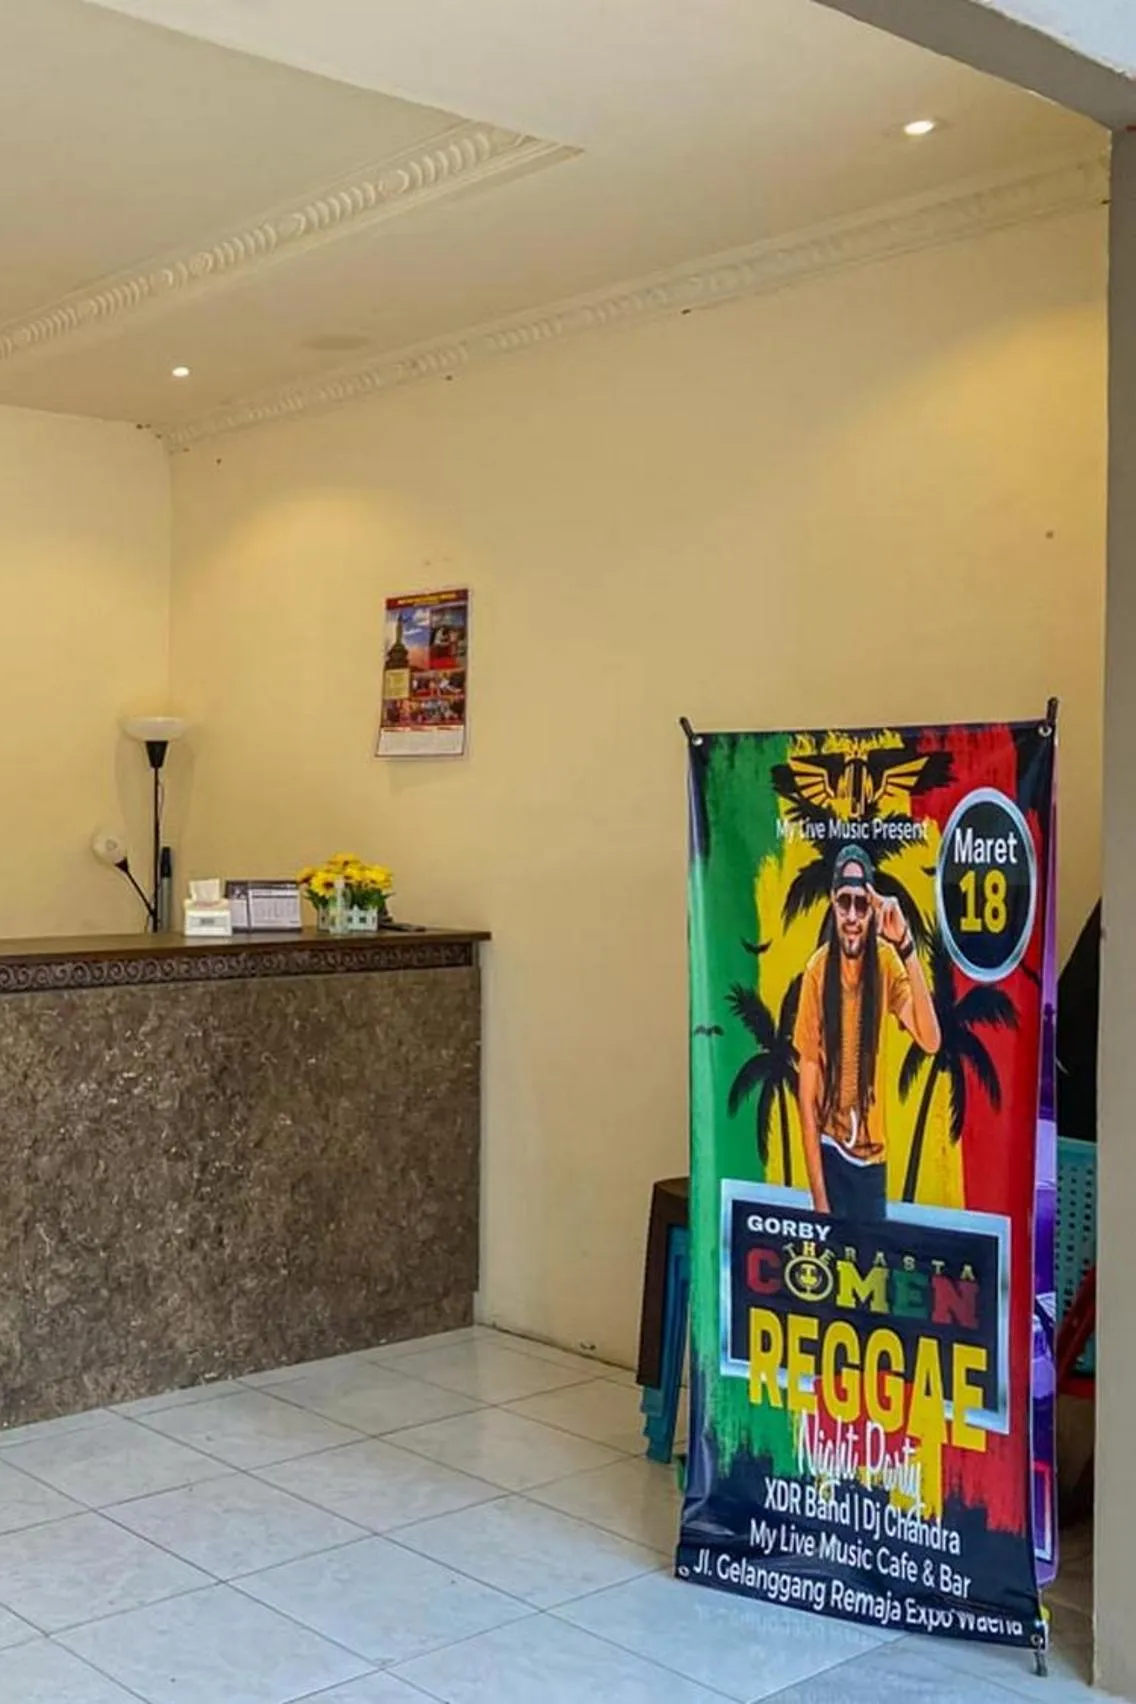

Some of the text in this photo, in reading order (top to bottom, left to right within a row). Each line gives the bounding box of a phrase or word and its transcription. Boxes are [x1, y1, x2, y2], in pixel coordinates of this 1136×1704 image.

[776, 819, 928, 844] My Live Music Present
[954, 827, 1017, 864] Maret
[960, 869, 1007, 934] 18
[747, 1215, 831, 1241] GORBY
[782, 1241, 975, 1281] THE RASTA
[749, 1307, 987, 1452] REGGAE
[798, 1407, 924, 1518] Night Party
[765, 1476, 801, 1515] XDR
[805, 1484, 850, 1525] Band
[863, 1497, 880, 1541] Dj
[884, 1504, 961, 1555] Chandra
[693, 1548, 712, 1576] Jl.
[717, 1553, 826, 1611] Gelanggang
[830, 1579, 901, 1625] Remaja
[905, 1597, 953, 1632] Expo
[750, 1517, 971, 1599] My Live Music Cafe & Bar
